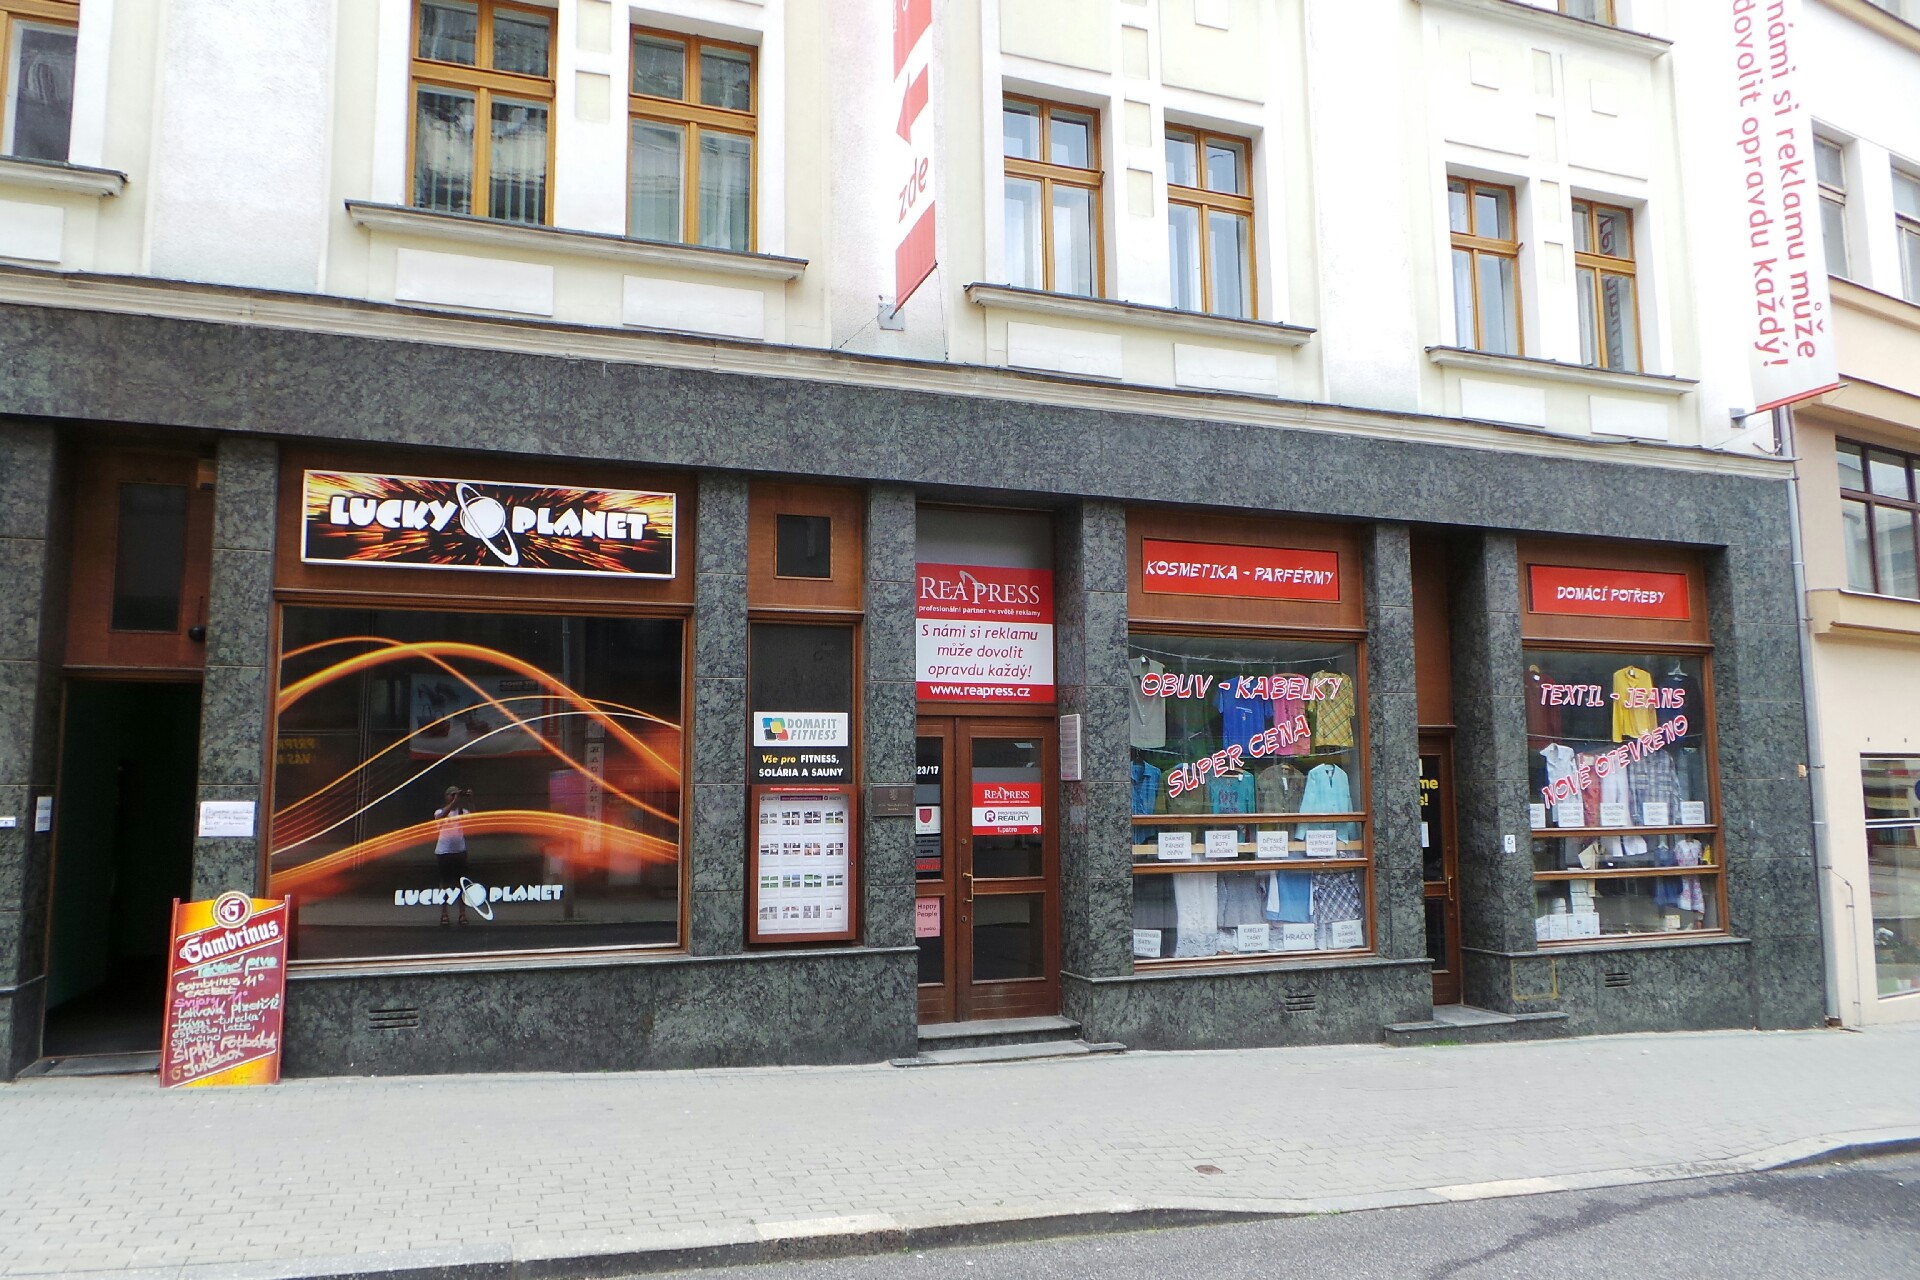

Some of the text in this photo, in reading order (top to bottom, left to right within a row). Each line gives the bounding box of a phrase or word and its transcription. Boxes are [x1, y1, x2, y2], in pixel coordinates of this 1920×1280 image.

[1733, 0, 1788, 367] dovolit opravdu každý!
[1767, 0, 1823, 358] námi si reklamu může
[899, 157, 928, 224] zde
[330, 496, 647, 540] LUCKY PLANET
[1145, 560, 1238, 580] KOSMETIKA
[1254, 566, 1334, 585] PARFÉRMY
[1557, 585, 1665, 604] DOMÁCÍ POTŘEBY
[962, 607, 986, 615] partner
[997, 607, 1014, 616] světě
[1015, 609, 1041, 618] reklamy
[922, 624, 1038, 641] S námi si reklamu
[937, 643, 1023, 659] může dovolit
[928, 664, 1032, 681] opravdu každý!
[930, 686, 1030, 699] www.reapress.cz
[1141, 673, 1213, 698] OBUV
[1235, 676, 1343, 700] KABELKY
[1540, 684, 1604, 707] TEXTIL
[1624, 687, 1685, 709] JEANS
[787, 718, 837, 729] DOMAFIT
[790, 730, 837, 740] FITNESS
[1594, 715, 1688, 777] OTEVŘENO
[762, 754, 839, 766] Vše pro FITNESS,
[1168, 715, 1311, 798] SUPER CENA
[759, 767, 843, 777] SOLÁRIA A SAUNY
[394, 884, 563, 906] LUCKY PLANET
[179, 920, 279, 963] Gambrinus
[1286, 931, 1313, 941] HRAČKY
